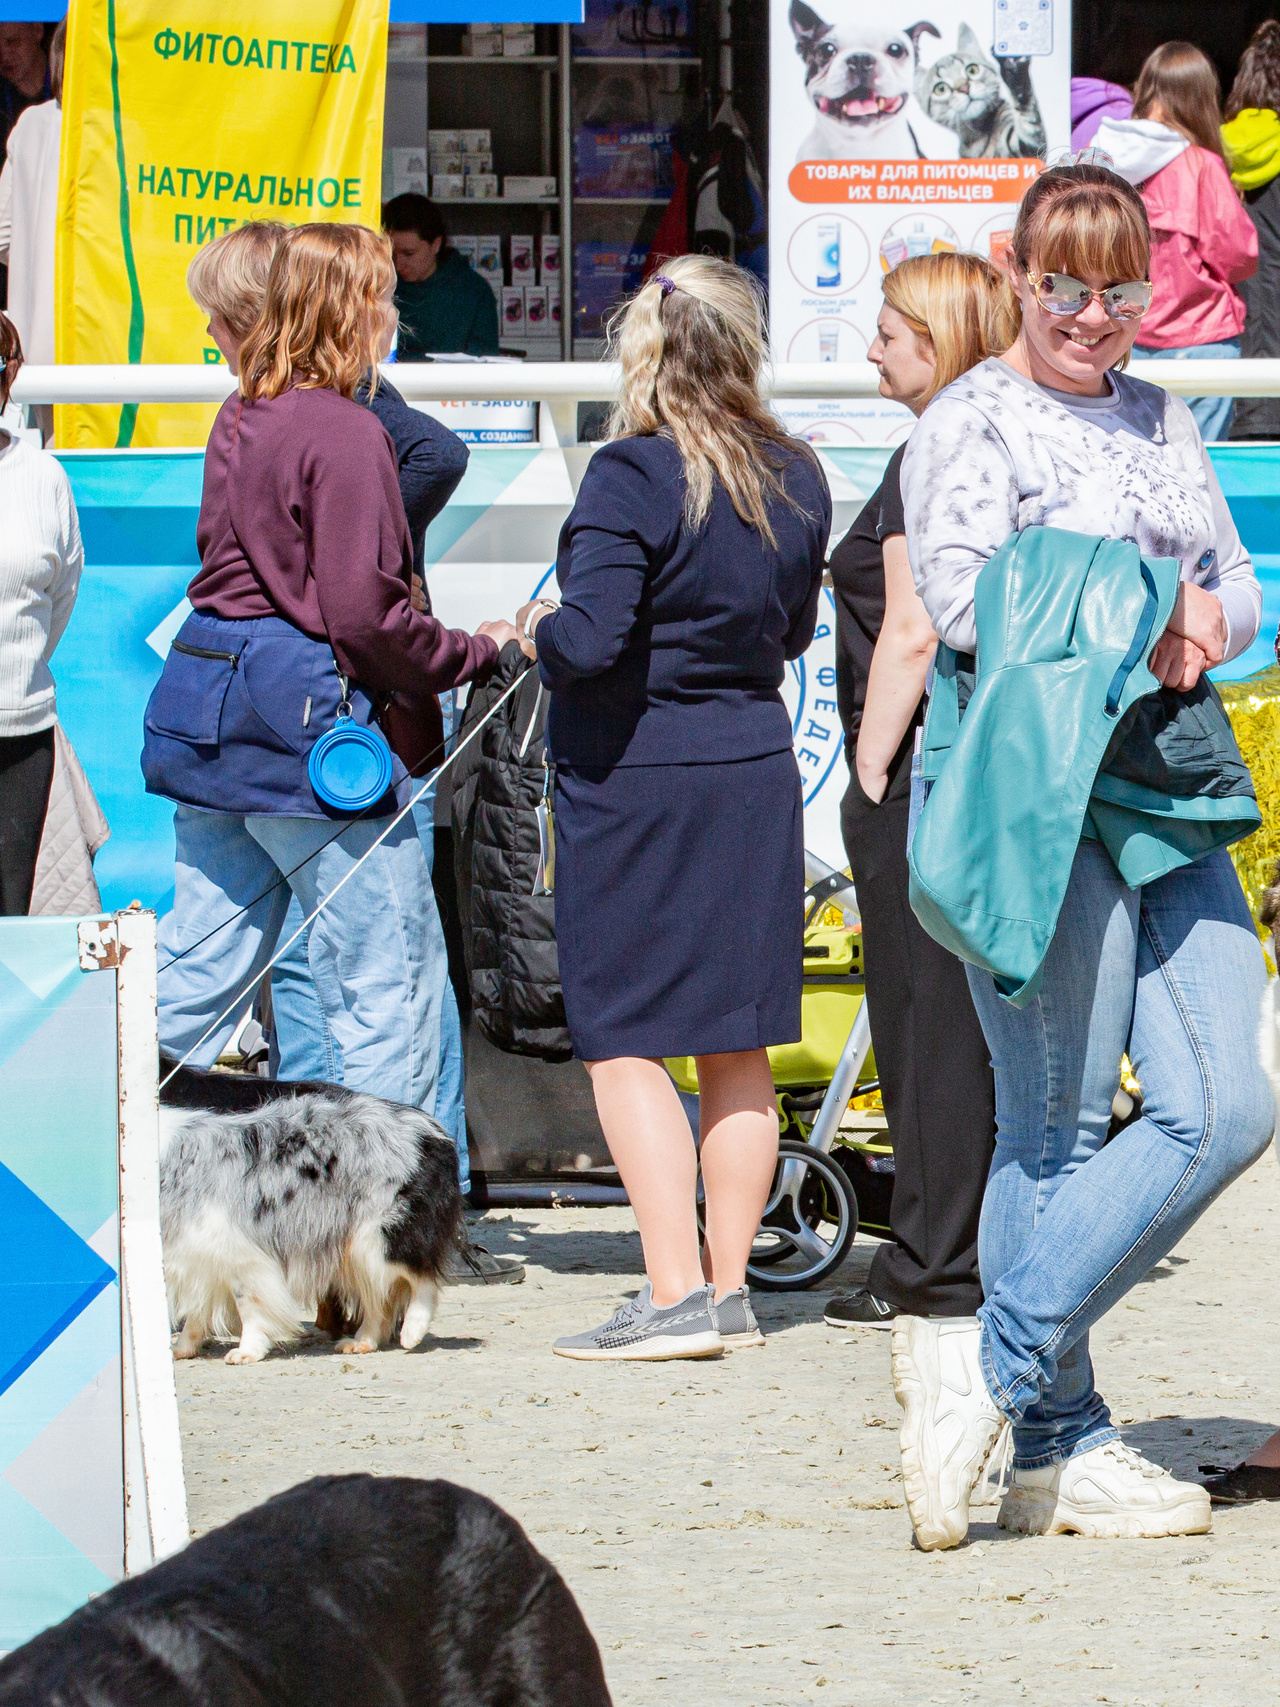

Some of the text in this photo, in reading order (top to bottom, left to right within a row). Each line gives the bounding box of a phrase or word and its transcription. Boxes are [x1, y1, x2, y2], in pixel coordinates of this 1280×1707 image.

[154, 28, 356, 73] ФИТОАПТЕКА
[138, 164, 362, 208] НАТУРАЛЬНОЕ
[805, 164, 1037, 181] ТОВАРЫ ДЛЯ ПИТОМЦЕВ И
[848, 185, 993, 201] ИХ ВЛАДЕЛЬЦЕВ
